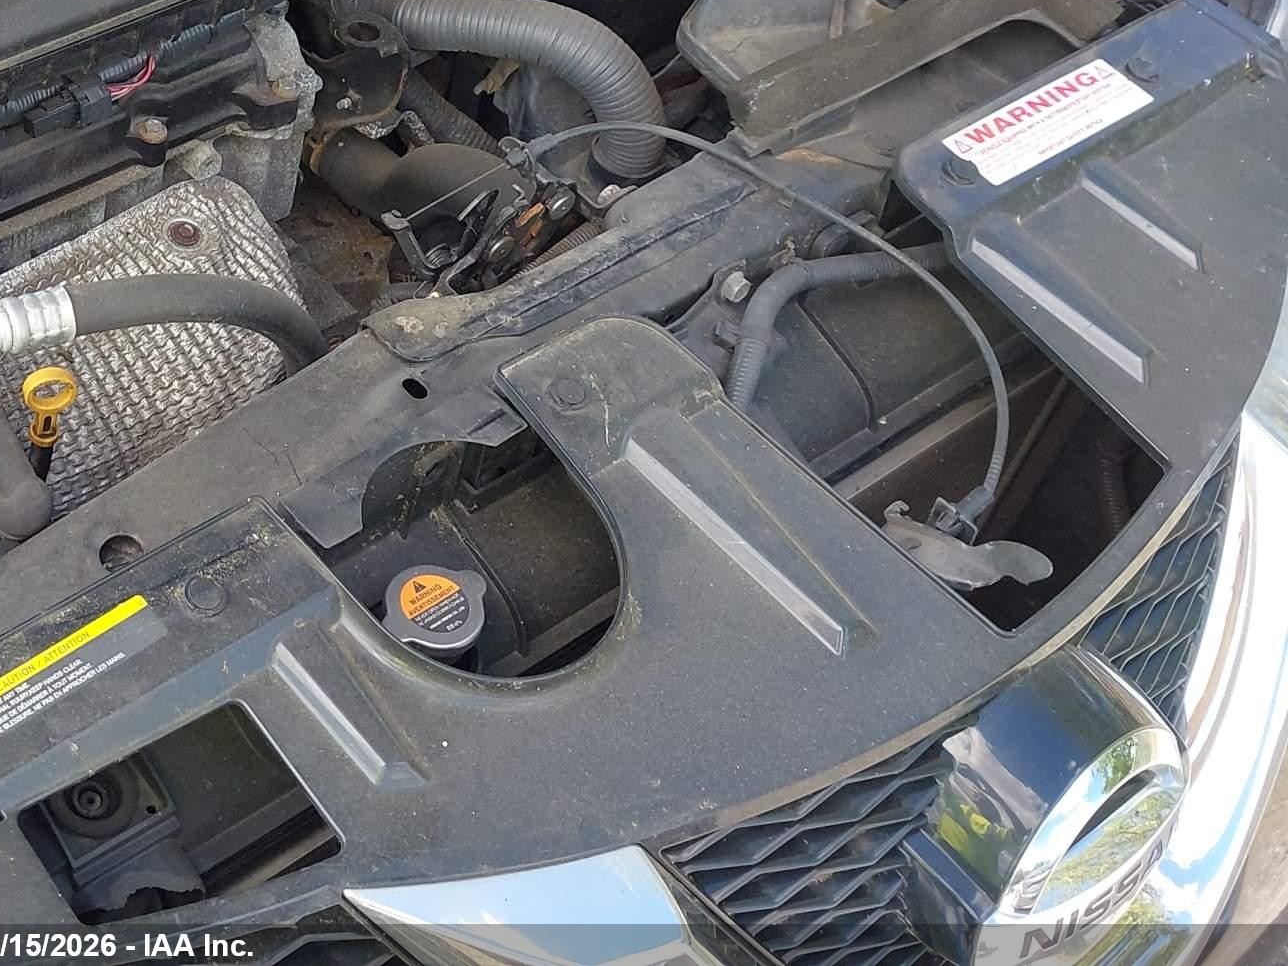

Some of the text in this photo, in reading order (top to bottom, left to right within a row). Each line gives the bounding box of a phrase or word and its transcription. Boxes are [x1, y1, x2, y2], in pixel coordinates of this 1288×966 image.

[964, 71, 1099, 144] WARNING
[408, 585, 456, 616] AVERTISSEMENT
[409, 583, 442, 606] WARNING
[43, 631, 90, 662] ATTENTION
[42, 695, 54, 706] PAS
[62, 669, 97, 694] APPROCHER
[95, 662, 108, 673] LES
[43, 670, 63, 685] HANDS
[3, 690, 16, 702] ANY
[8, 708, 19, 718] DE
[52, 677, 68, 690] TOUT
